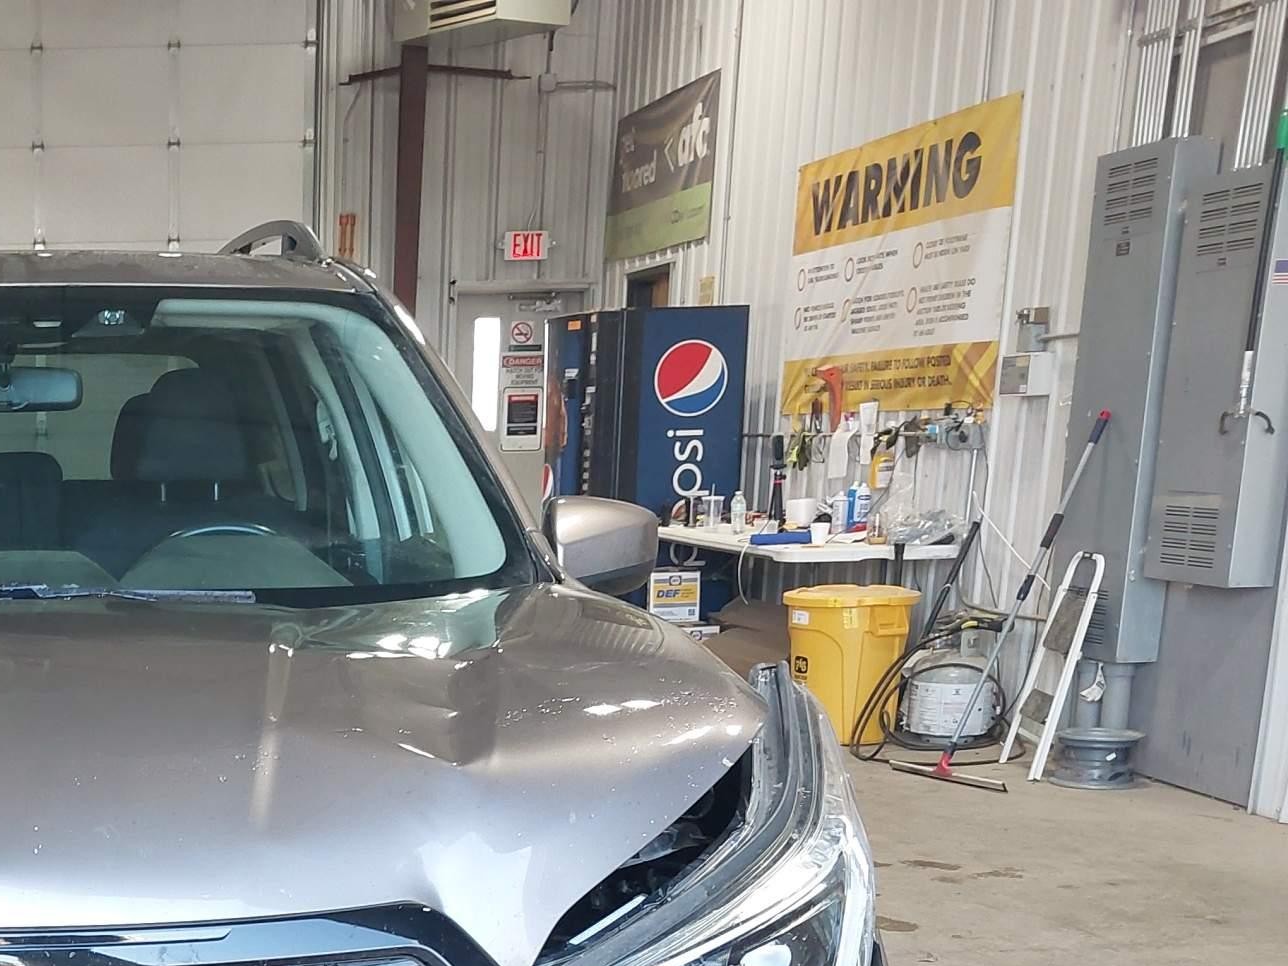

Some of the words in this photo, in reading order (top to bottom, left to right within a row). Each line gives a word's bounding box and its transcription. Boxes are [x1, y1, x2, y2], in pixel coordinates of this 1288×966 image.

[812, 131, 982, 236] WARNING
[513, 233, 542, 256] EXIT
[508, 357, 542, 365] DANGER
[656, 588, 681, 598] DEF
